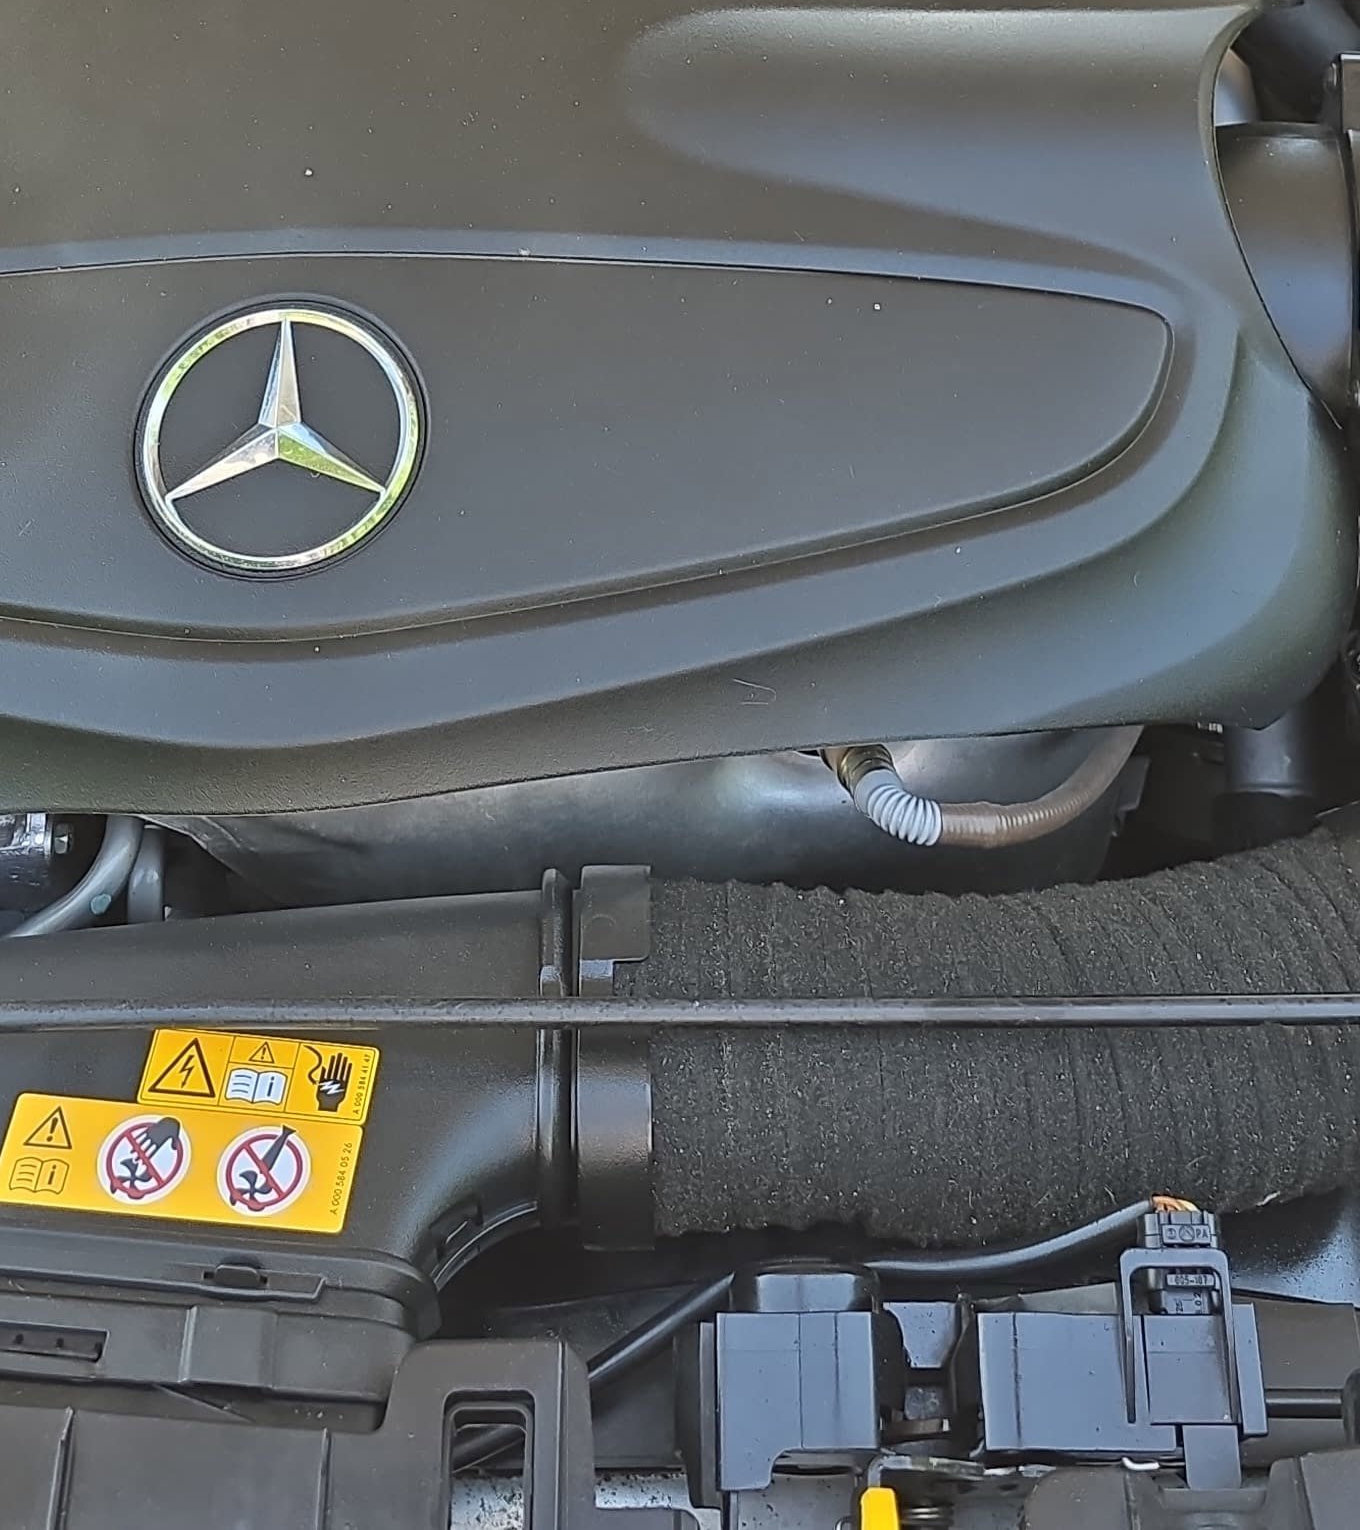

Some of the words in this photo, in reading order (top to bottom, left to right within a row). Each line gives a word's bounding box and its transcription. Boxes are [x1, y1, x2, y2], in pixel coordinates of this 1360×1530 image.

[353, 1090, 363, 1107] 000
[344, 1142, 353, 1154] 26
[340, 1156, 350, 1169] 05
[336, 1170, 347, 1188] 584
[332, 1188, 343, 1206] 000
[330, 1206, 338, 1215] A
[1195, 1228, 1208, 1239] PA
